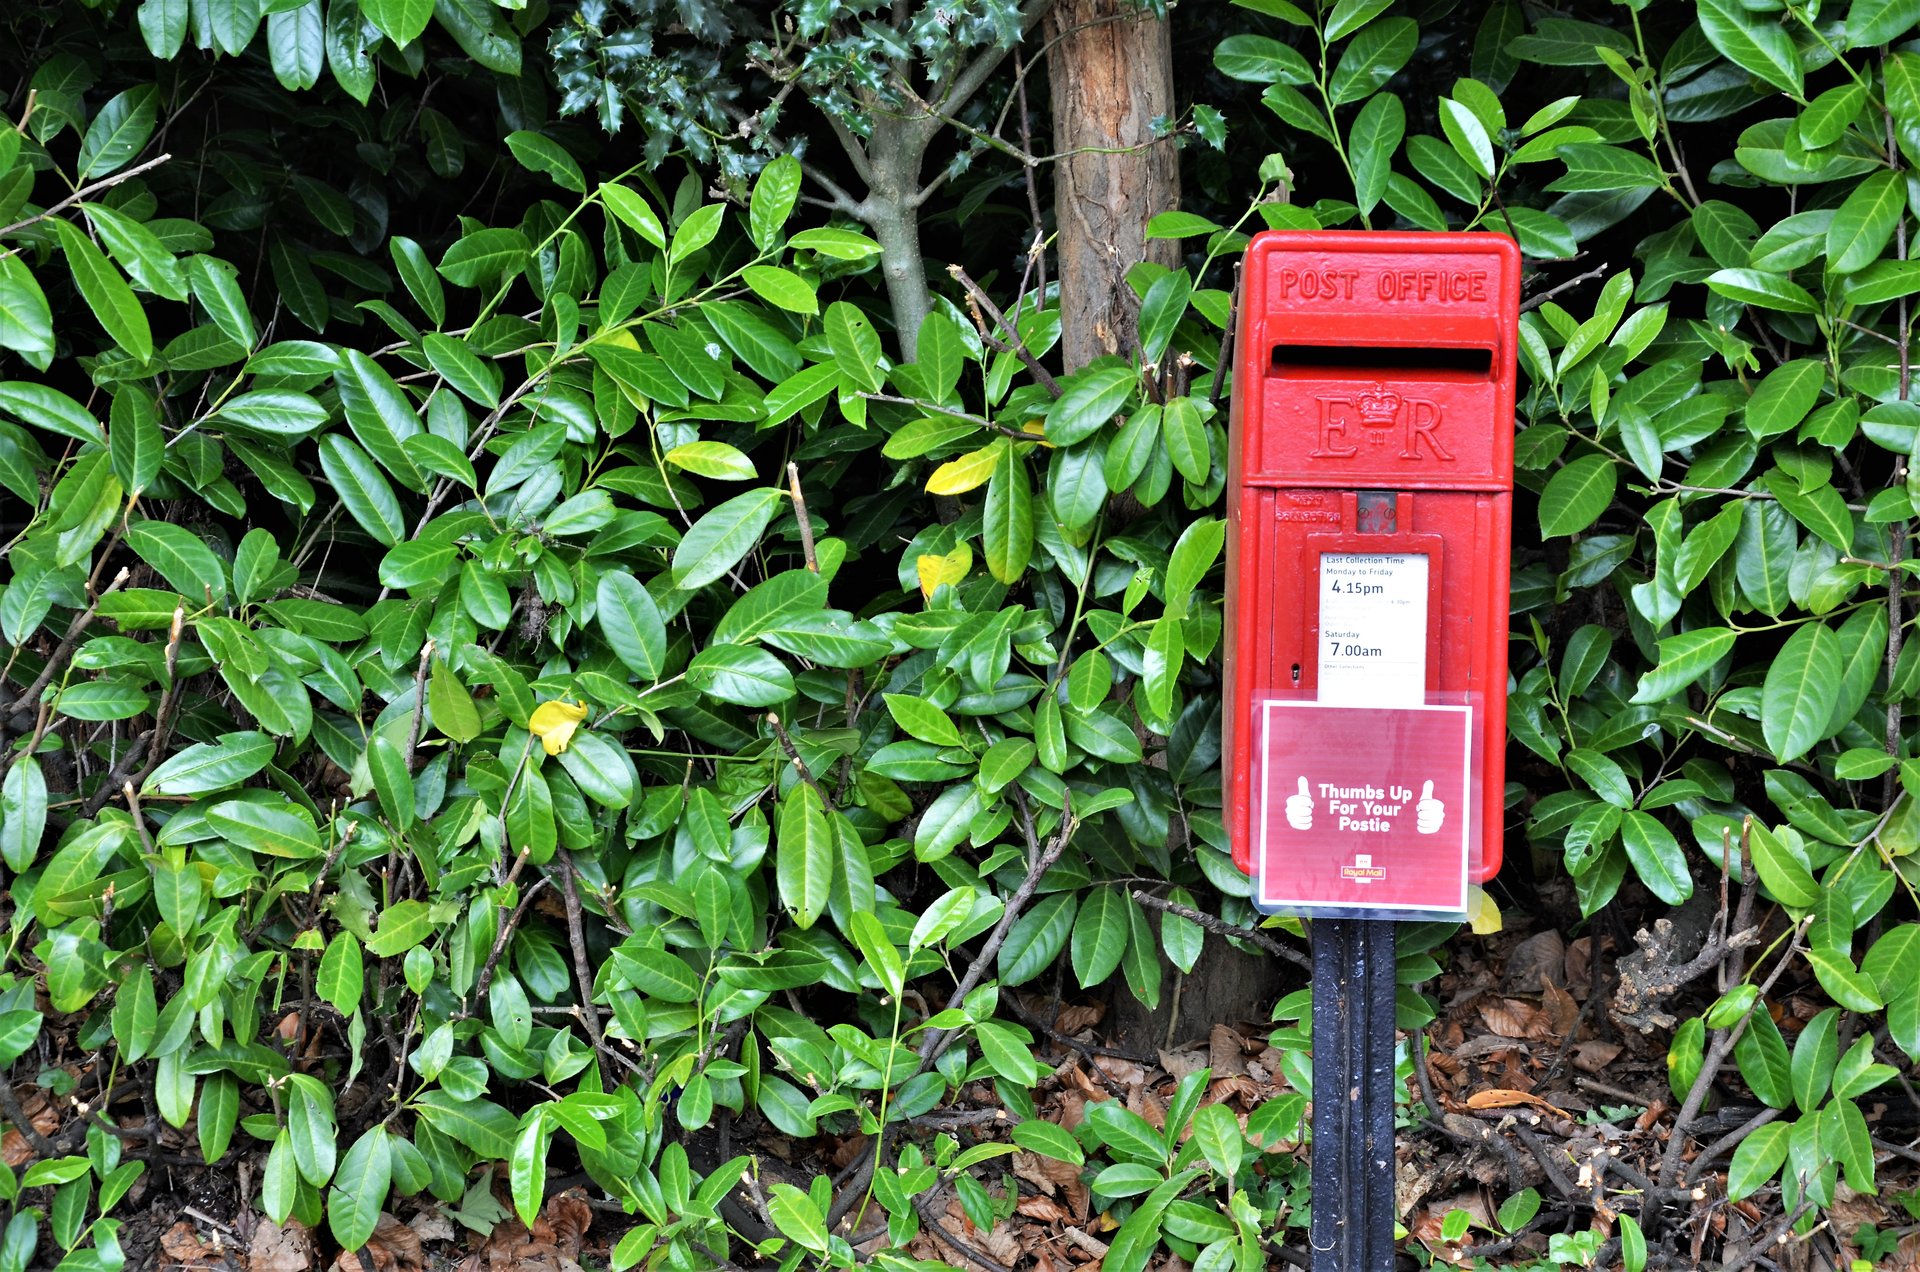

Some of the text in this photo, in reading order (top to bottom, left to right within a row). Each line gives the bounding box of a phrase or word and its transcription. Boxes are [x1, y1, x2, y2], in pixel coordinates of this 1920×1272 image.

[1280, 268, 1487, 301] POST OFFICE
[1309, 395, 1359, 459] E
[1398, 397, 1456, 461] R
[1326, 556, 1405, 565] Last Collection Time
[1326, 568, 1356, 576] Monday
[1369, 568, 1394, 577] Friday
[1331, 579, 1384, 596] 4.15pm
[1325, 630, 1360, 639] Saturday
[1331, 642, 1382, 657] 7.00am
[1318, 783, 1413, 804] Thumbs Up
[1329, 800, 1402, 817] For Your
[1339, 816, 1391, 832] Postie
[1343, 868, 1383, 877] Royal Mail
